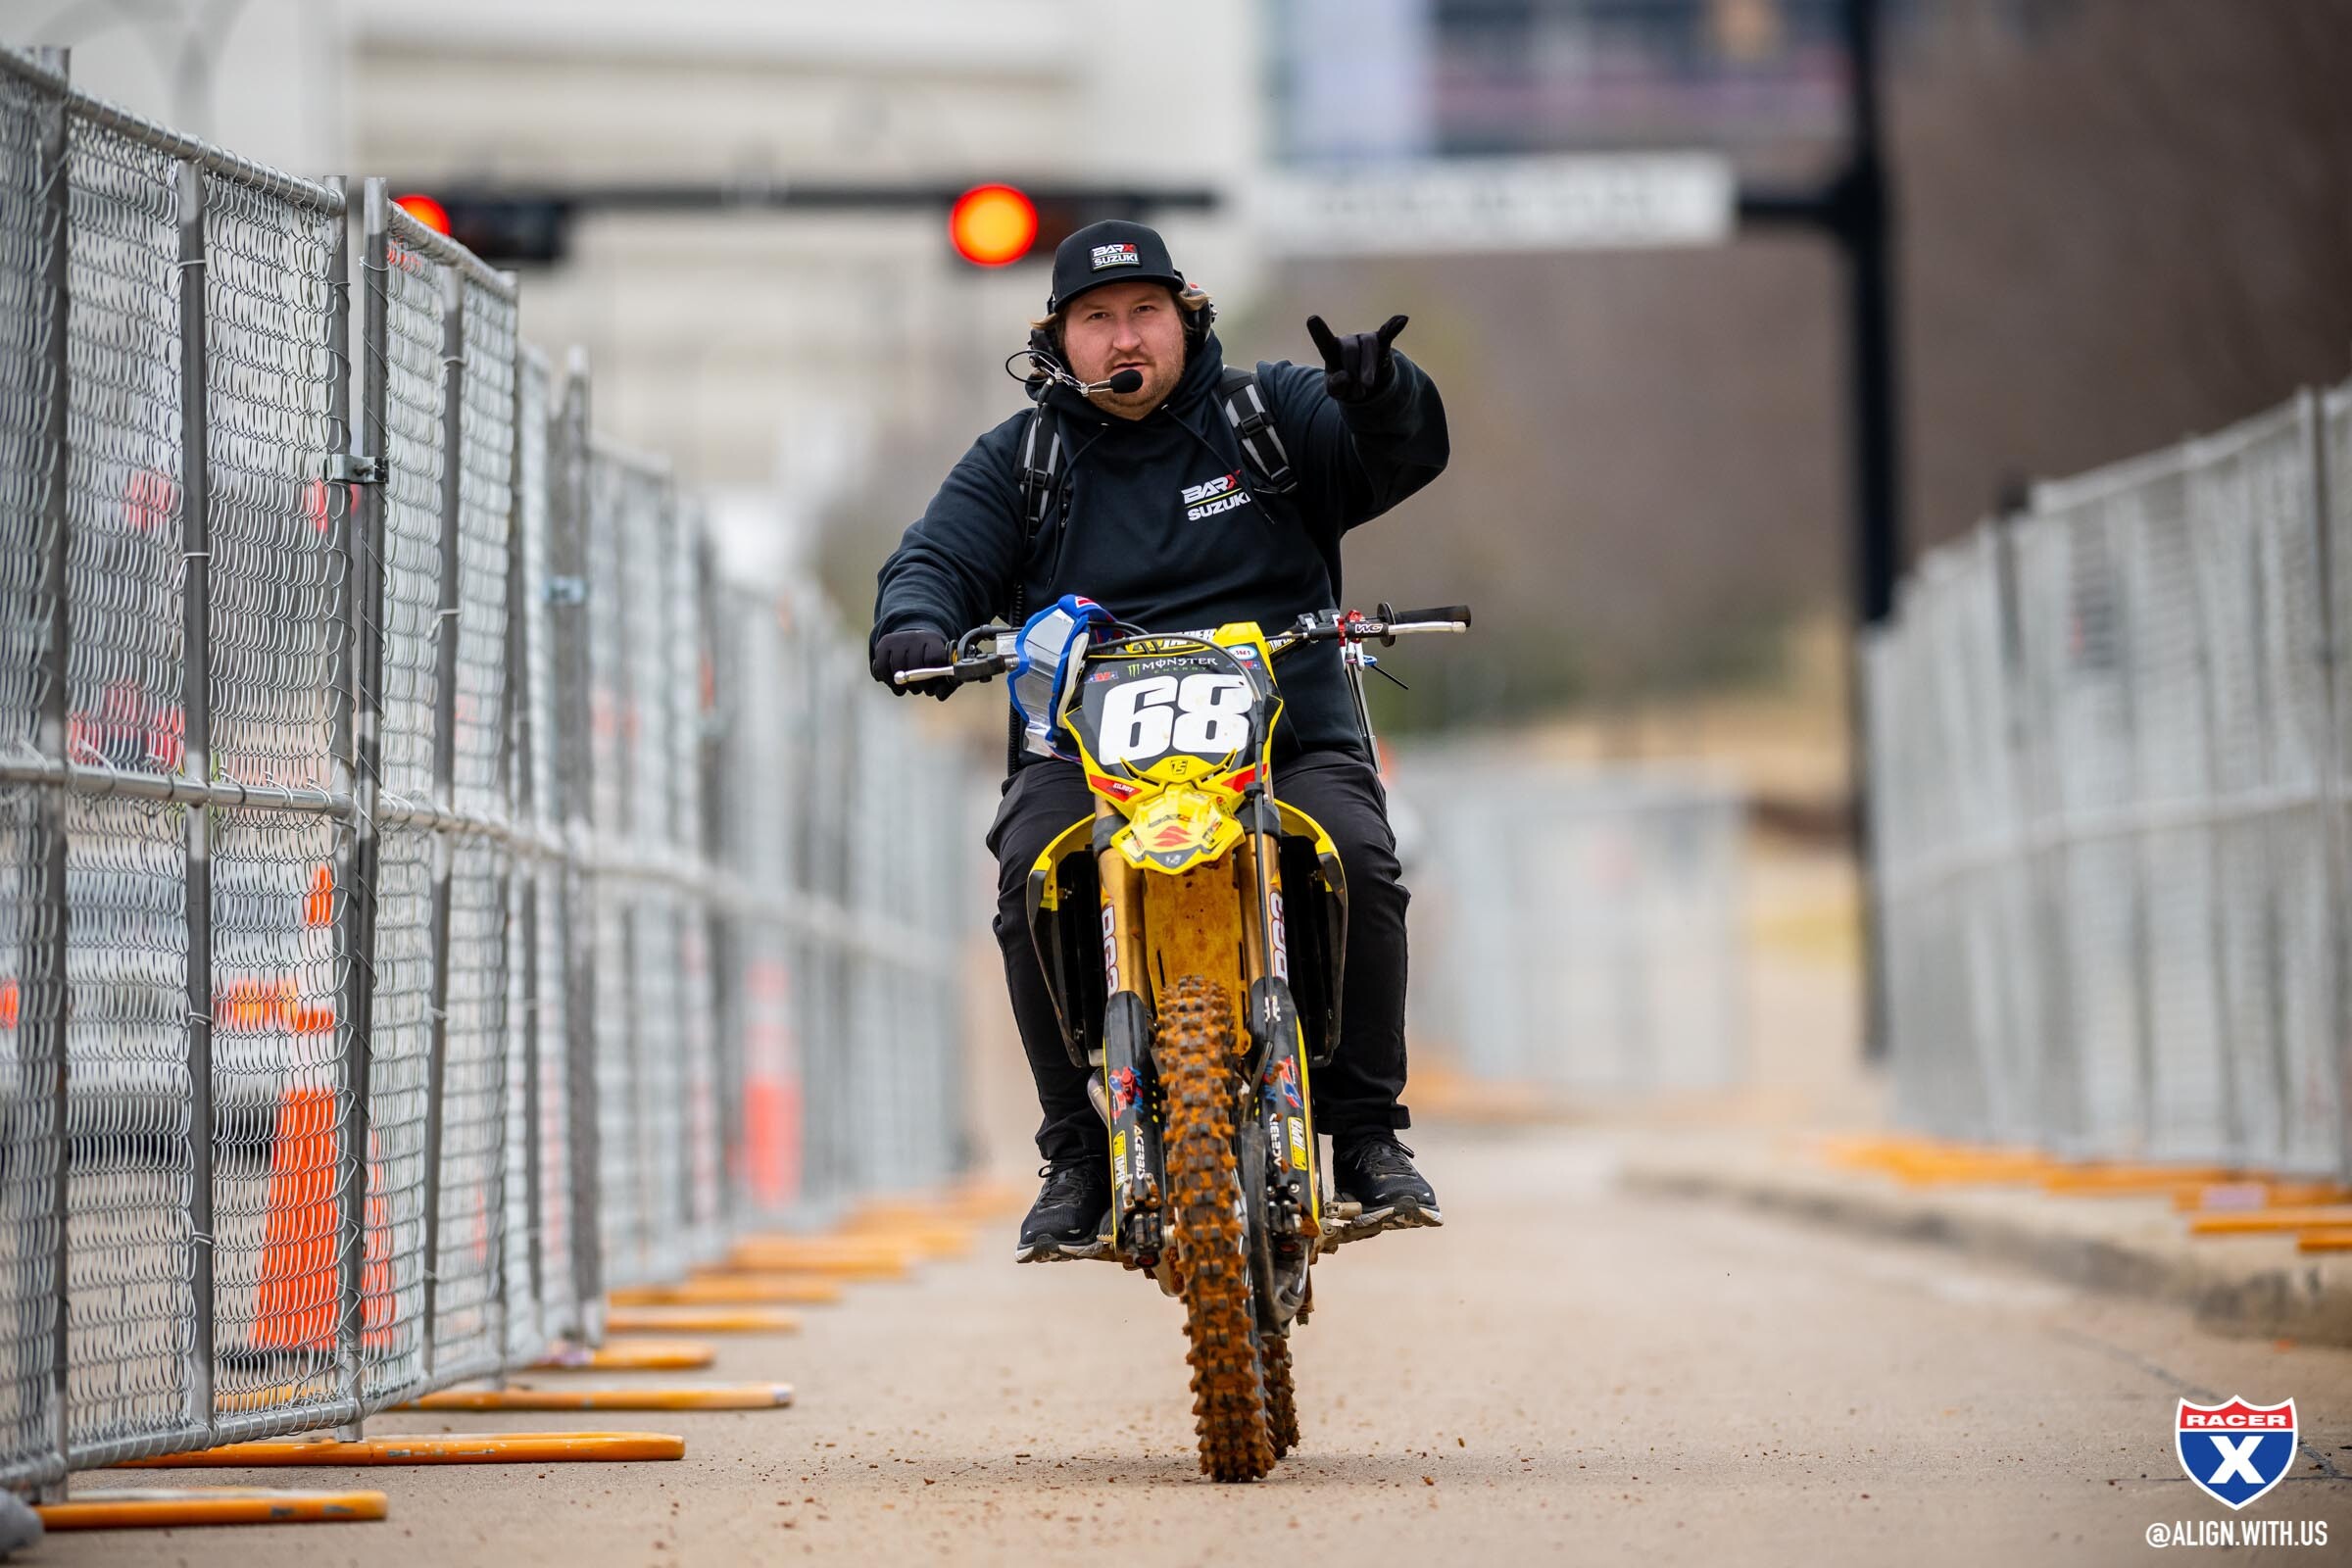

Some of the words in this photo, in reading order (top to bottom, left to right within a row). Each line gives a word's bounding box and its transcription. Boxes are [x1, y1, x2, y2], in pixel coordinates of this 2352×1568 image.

[1092, 244, 1137, 257] BARX
[1093, 254, 1139, 266] SUZUKI
[1142, 657, 1218, 671] MONSTER
[1099, 673, 1254, 766] 68
